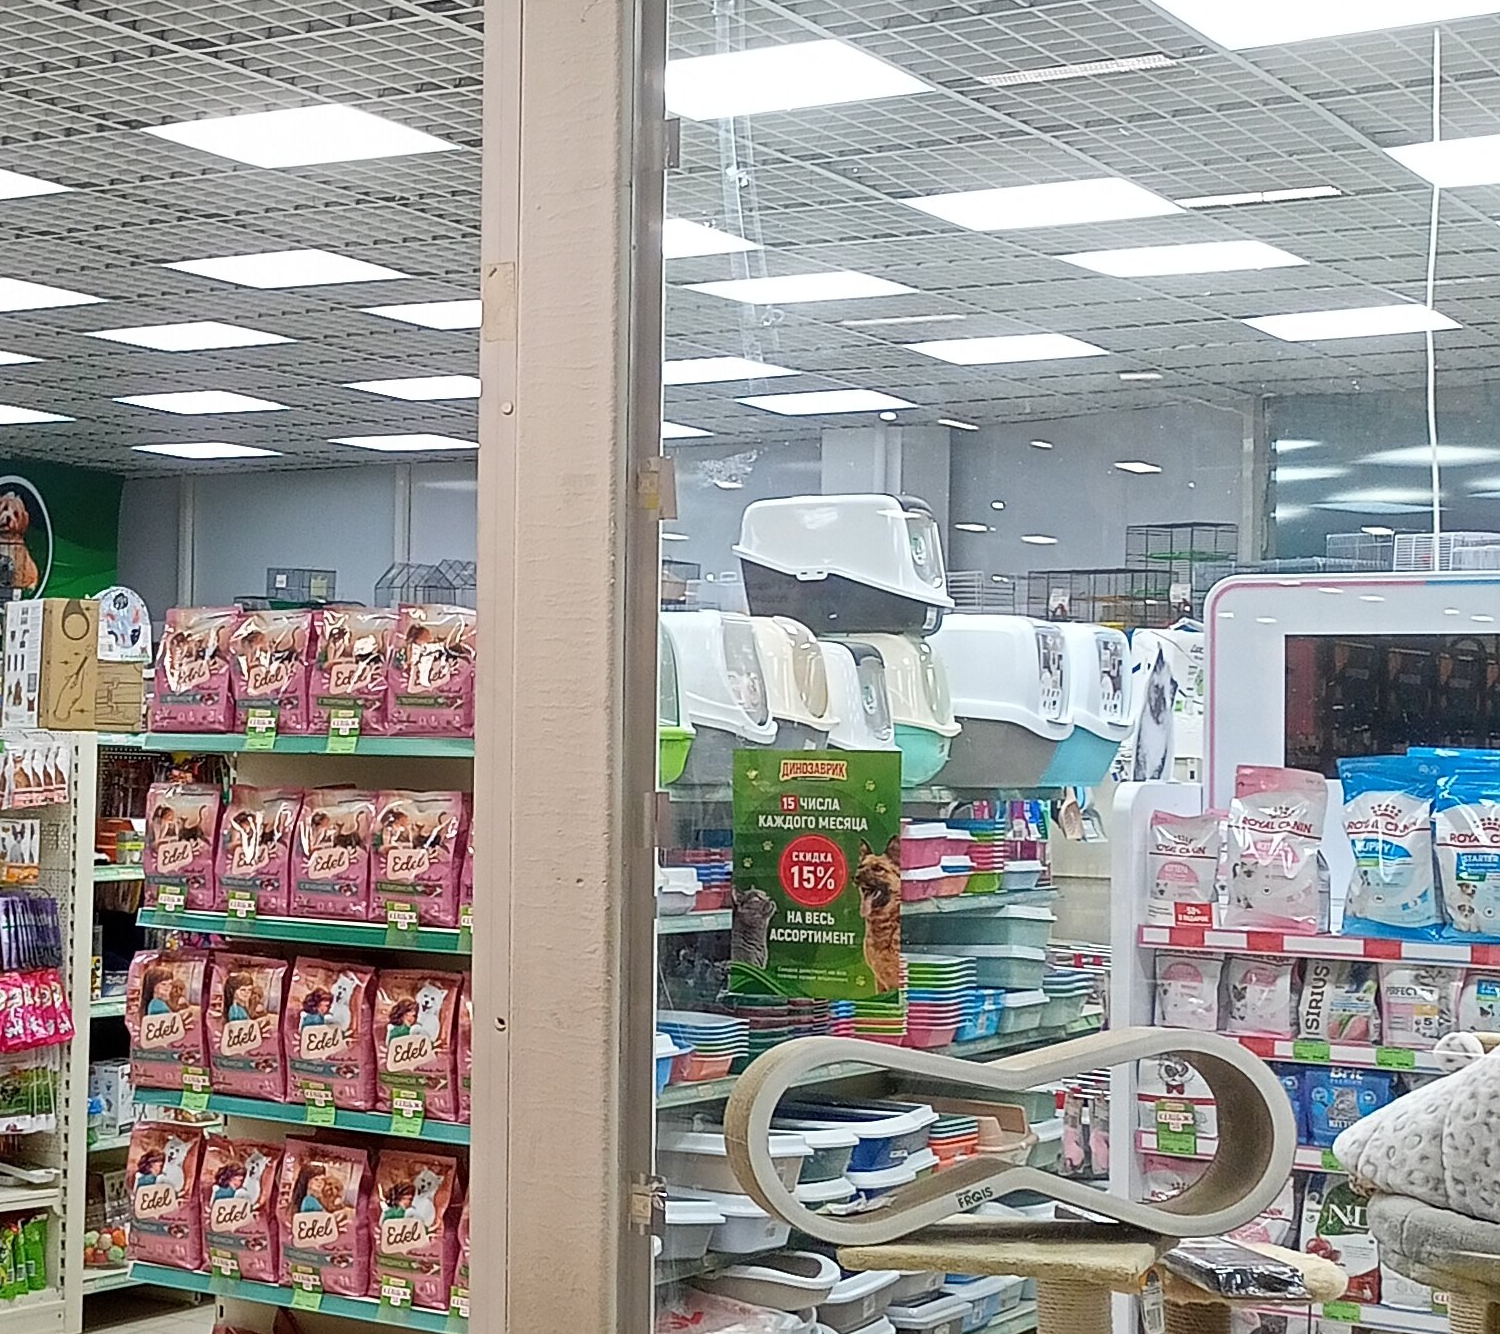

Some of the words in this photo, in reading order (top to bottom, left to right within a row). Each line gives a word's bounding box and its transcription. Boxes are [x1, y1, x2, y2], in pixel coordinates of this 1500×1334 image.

[253, 667, 284, 689] Edel
[781, 761, 847, 779] ДИНОЗАВРИК
[782, 798, 796, 810] 15
[799, 798, 840, 811] ЧИСЛА
[759, 815, 816, 829] КАЖДОГО
[818, 816, 868, 831] МЕСЯЦА
[163, 844, 189, 865] Edel
[314, 851, 345, 872] Edel
[392, 851, 425, 872] Edel
[792, 851, 833, 863] СКИДКА
[791, 866, 835, 890] 15%
[787, 912, 803, 925] НА
[805, 912, 835, 925] ВЕСЬ
[769, 928, 855, 945] АССОРТИМЕНТ
[1305, 965, 1330, 1031] SIRIUS
[146, 1017, 179, 1040] Edel
[227, 1024, 257, 1047] Edel
[307, 1030, 340, 1052] Edel
[393, 1041, 428, 1063] Edel
[141, 1188, 172, 1211] Edel
[216, 1202, 248, 1224] Edel
[298, 1217, 333, 1240] Edel
[387, 1223, 421, 1245] Edel
